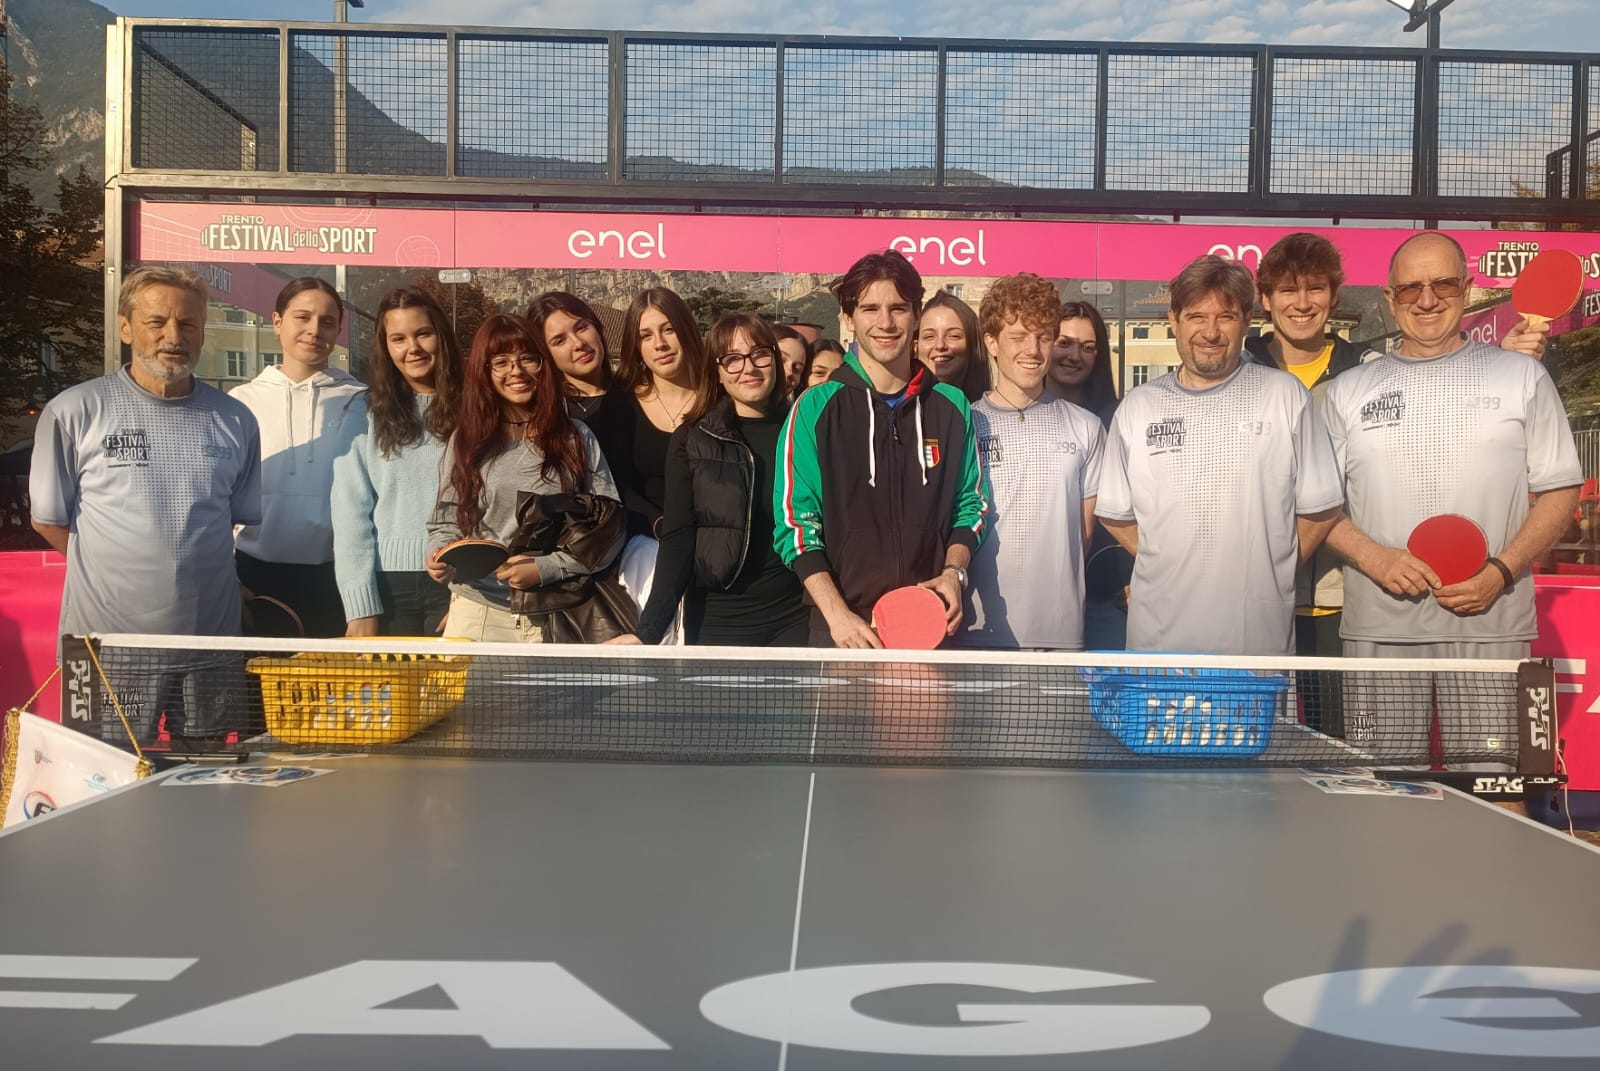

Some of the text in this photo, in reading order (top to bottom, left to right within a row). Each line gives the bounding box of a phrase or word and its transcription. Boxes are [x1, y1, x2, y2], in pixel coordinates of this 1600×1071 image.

[221, 215, 265, 224] TRENTO
[209, 225, 294, 251] FESTIVAL
[293, 230, 319, 248] dello
[318, 227, 377, 254] SPORT
[568, 222, 667, 258] enel
[889, 229, 986, 266] enel
[1498, 241, 1539, 251] TRENTO
[1207, 244, 1263, 272] en
[1486, 251, 1539, 276] FEST
[1471, 315, 1497, 343] nel
[1364, 396, 1405, 414] FESTIVAL
[1372, 406, 1405, 423] SPORT
[106, 434, 150, 448] FESTIVAL
[980, 438, 1003, 451] TIVAL
[1155, 434, 1186, 448] SPORT
[117, 447, 151, 461] SPORT
[981, 450, 1003, 462] PORT
[68, 660, 91, 721] STAG
[1528, 687, 1550, 750] STAG
[1473, 776, 1524, 793] STAG
